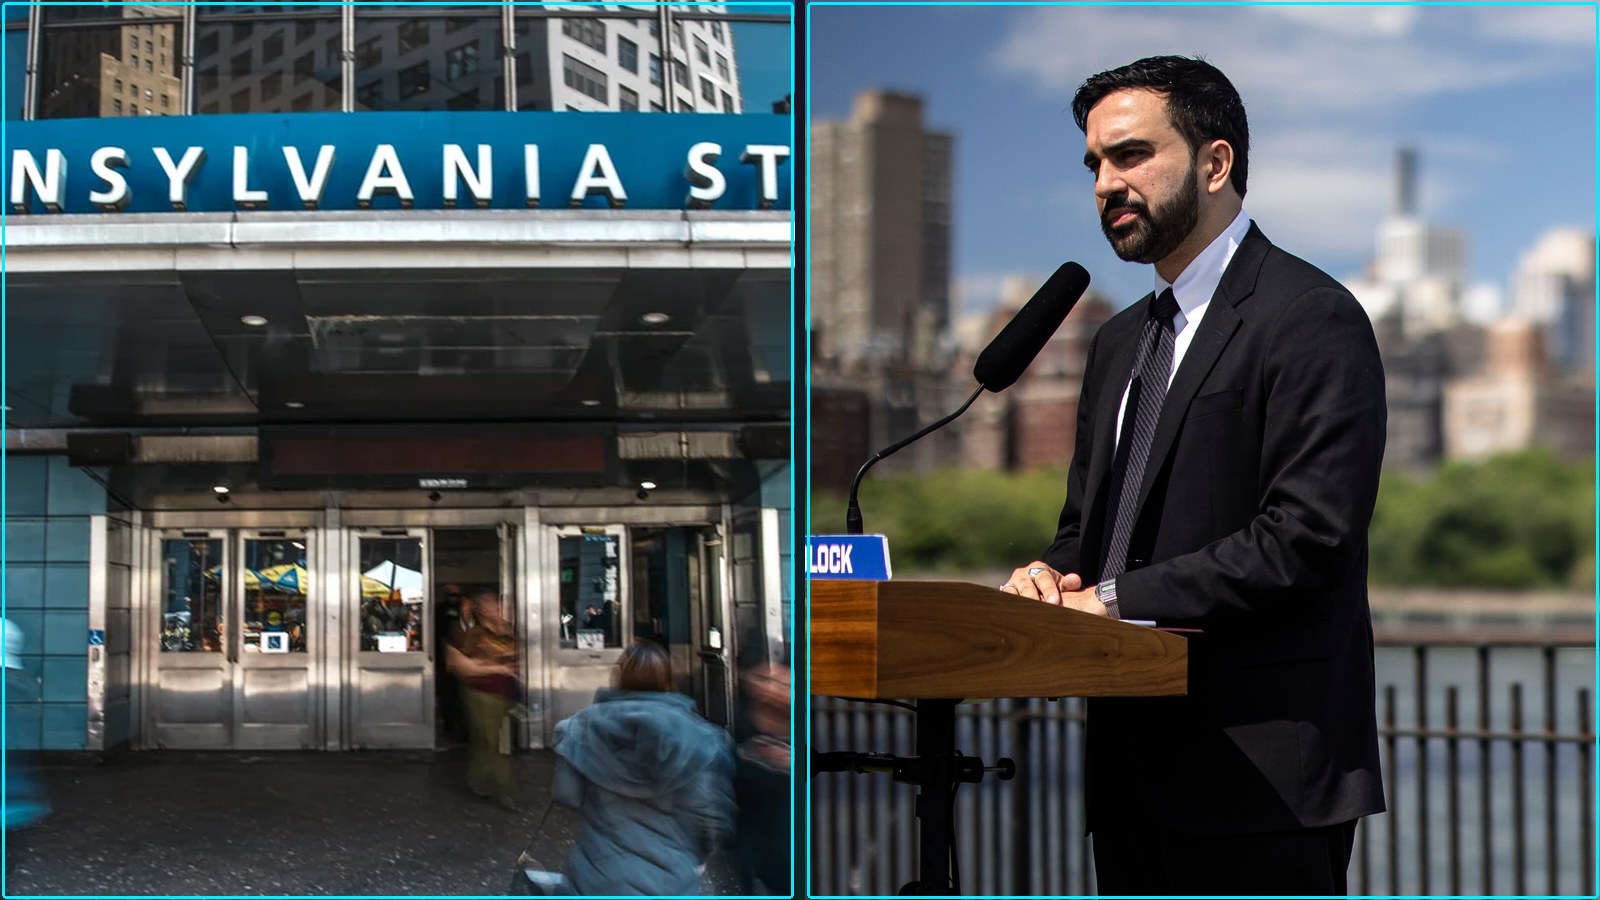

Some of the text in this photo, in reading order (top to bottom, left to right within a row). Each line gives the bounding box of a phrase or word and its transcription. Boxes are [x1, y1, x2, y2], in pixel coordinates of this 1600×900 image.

[10, 141, 791, 205] NSYLVANIA ST
[805, 544, 853, 573] LOCK
